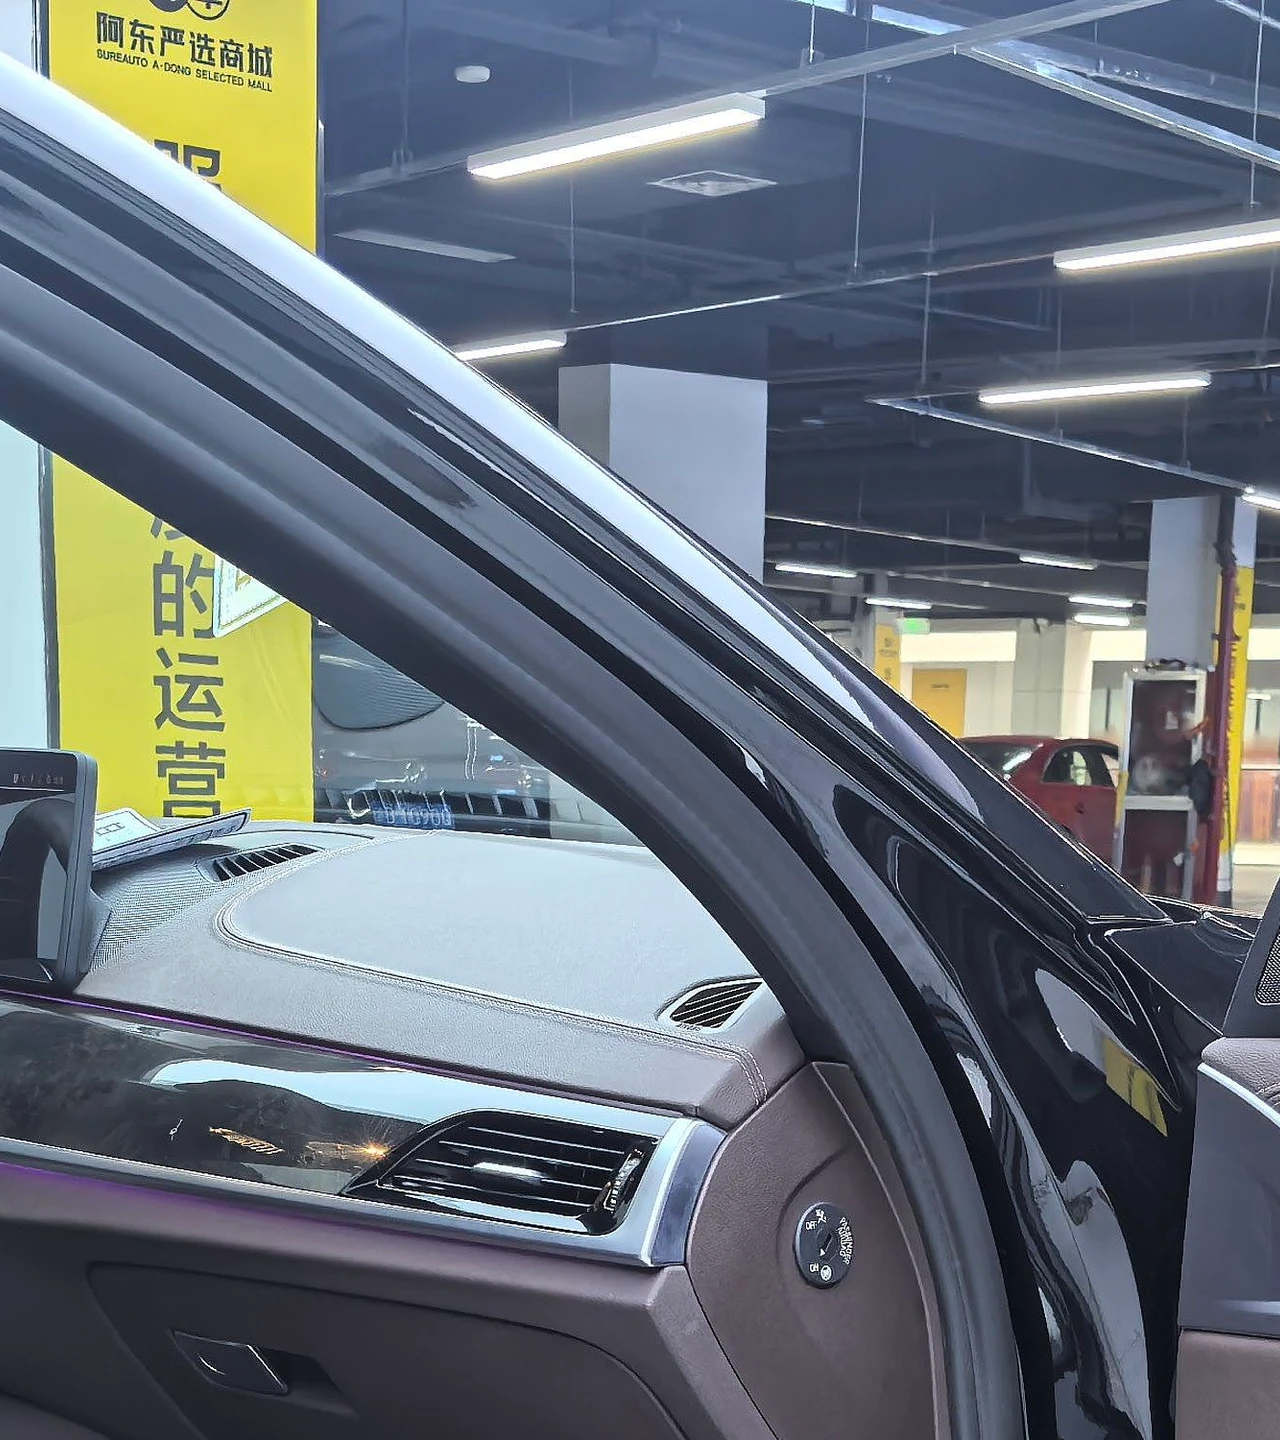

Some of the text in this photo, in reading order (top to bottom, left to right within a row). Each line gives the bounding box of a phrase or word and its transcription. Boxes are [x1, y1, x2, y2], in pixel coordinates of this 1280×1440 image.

[96, 11, 272, 77] 阿东严选商城
[96, 48, 148, 68] SUREAUTO
[195, 68, 245, 87] SELECTED
[247, 79, 273, 92] MALL
